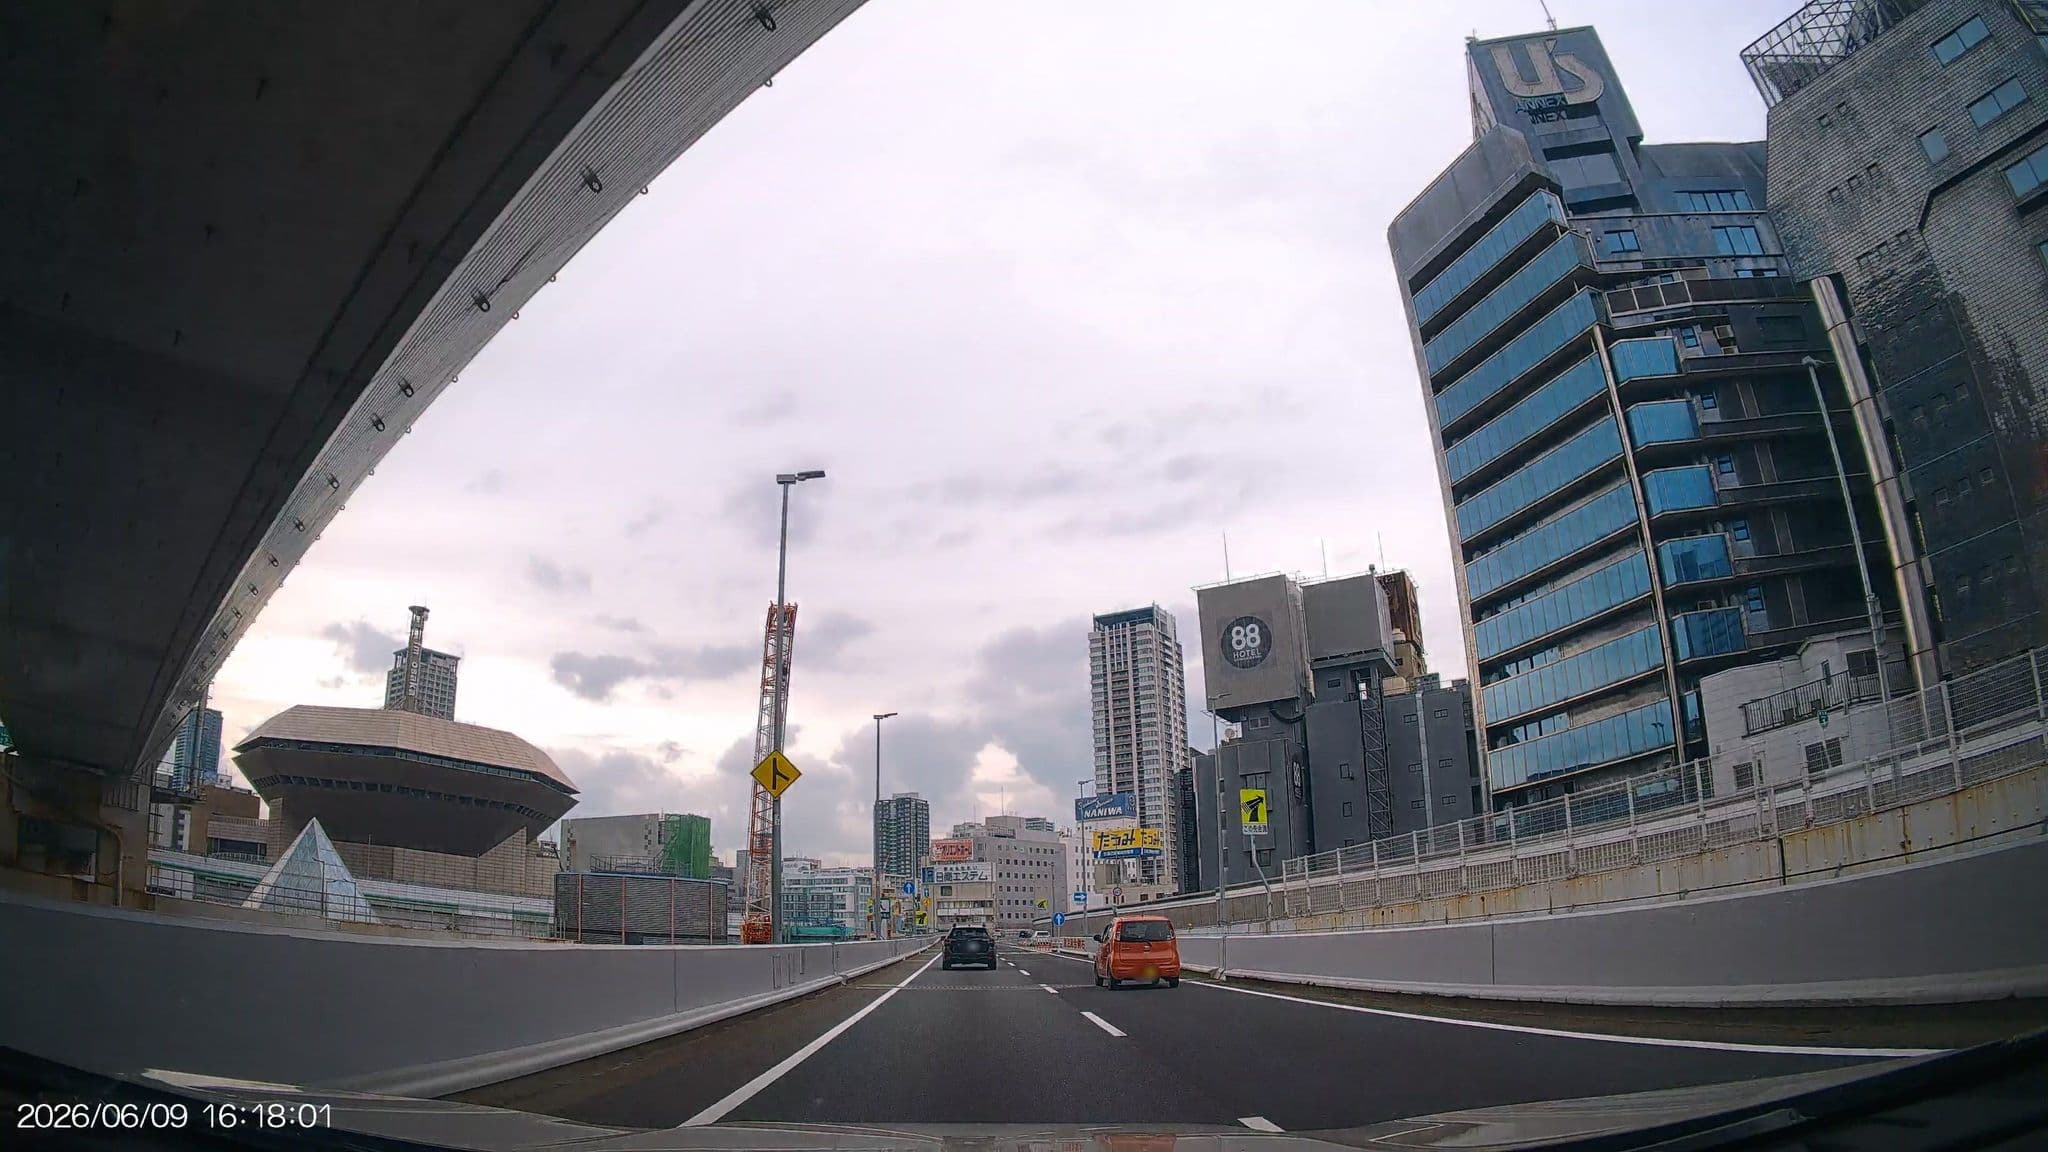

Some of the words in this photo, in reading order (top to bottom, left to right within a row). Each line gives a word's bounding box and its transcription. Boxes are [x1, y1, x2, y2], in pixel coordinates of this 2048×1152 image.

[1515, 94, 1568, 114] ANNEX
[1231, 623, 1261, 650] 88
[1233, 648, 1262, 659] HOTEL
[1084, 806, 1122, 818] NANIWA
